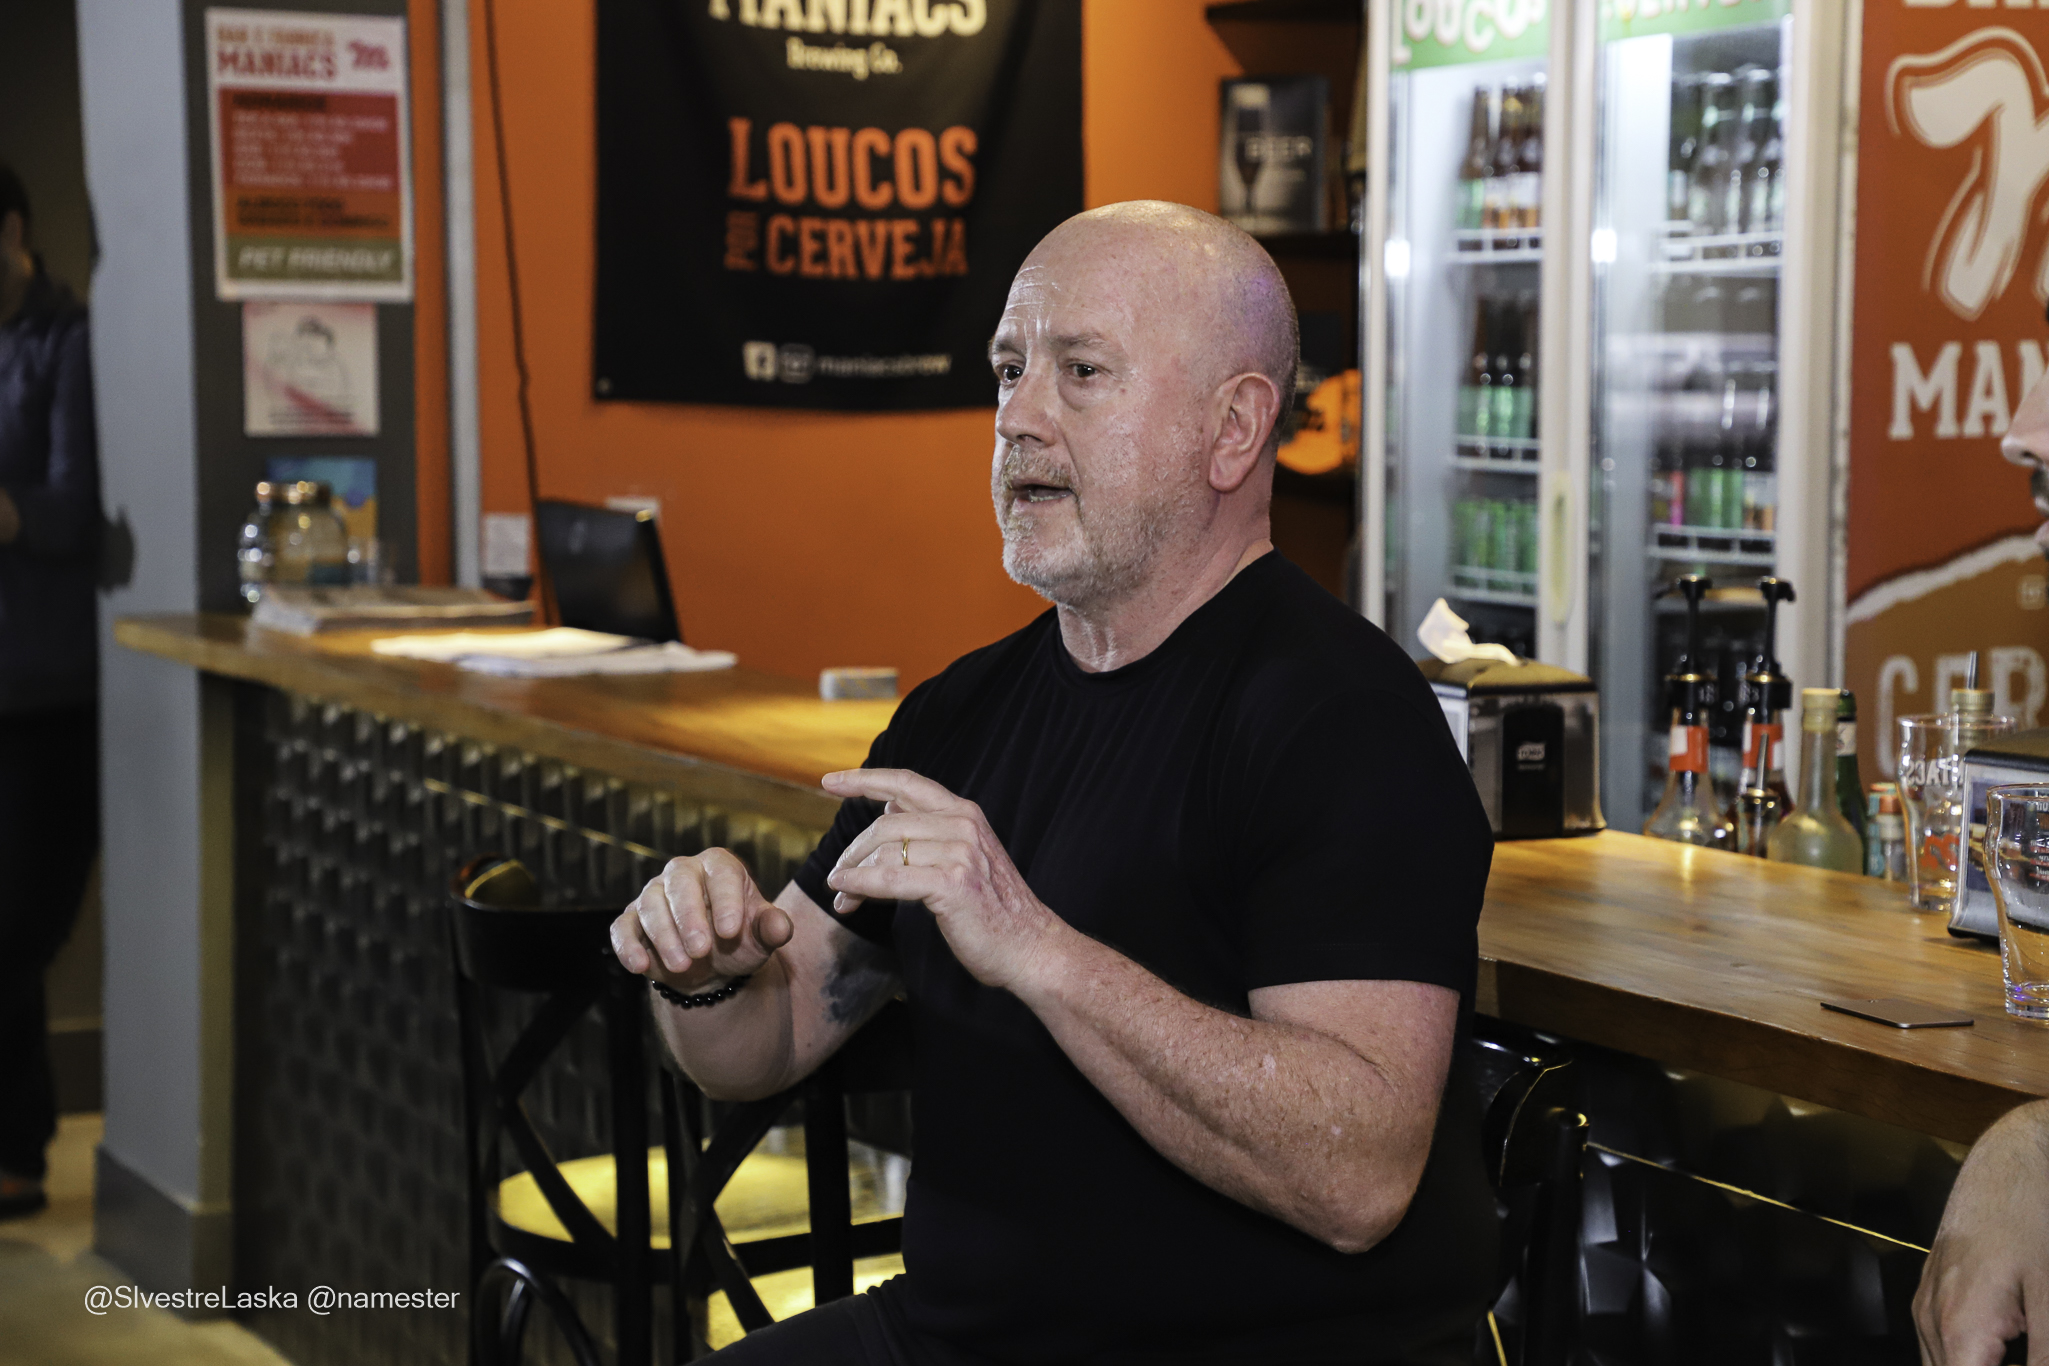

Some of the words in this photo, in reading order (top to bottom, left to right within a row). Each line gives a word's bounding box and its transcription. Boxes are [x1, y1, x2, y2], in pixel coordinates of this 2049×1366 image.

[786, 36, 869, 80] Brewing
[729, 117, 978, 210] LOUCOS
[765, 215, 969, 281] CERVEJA
